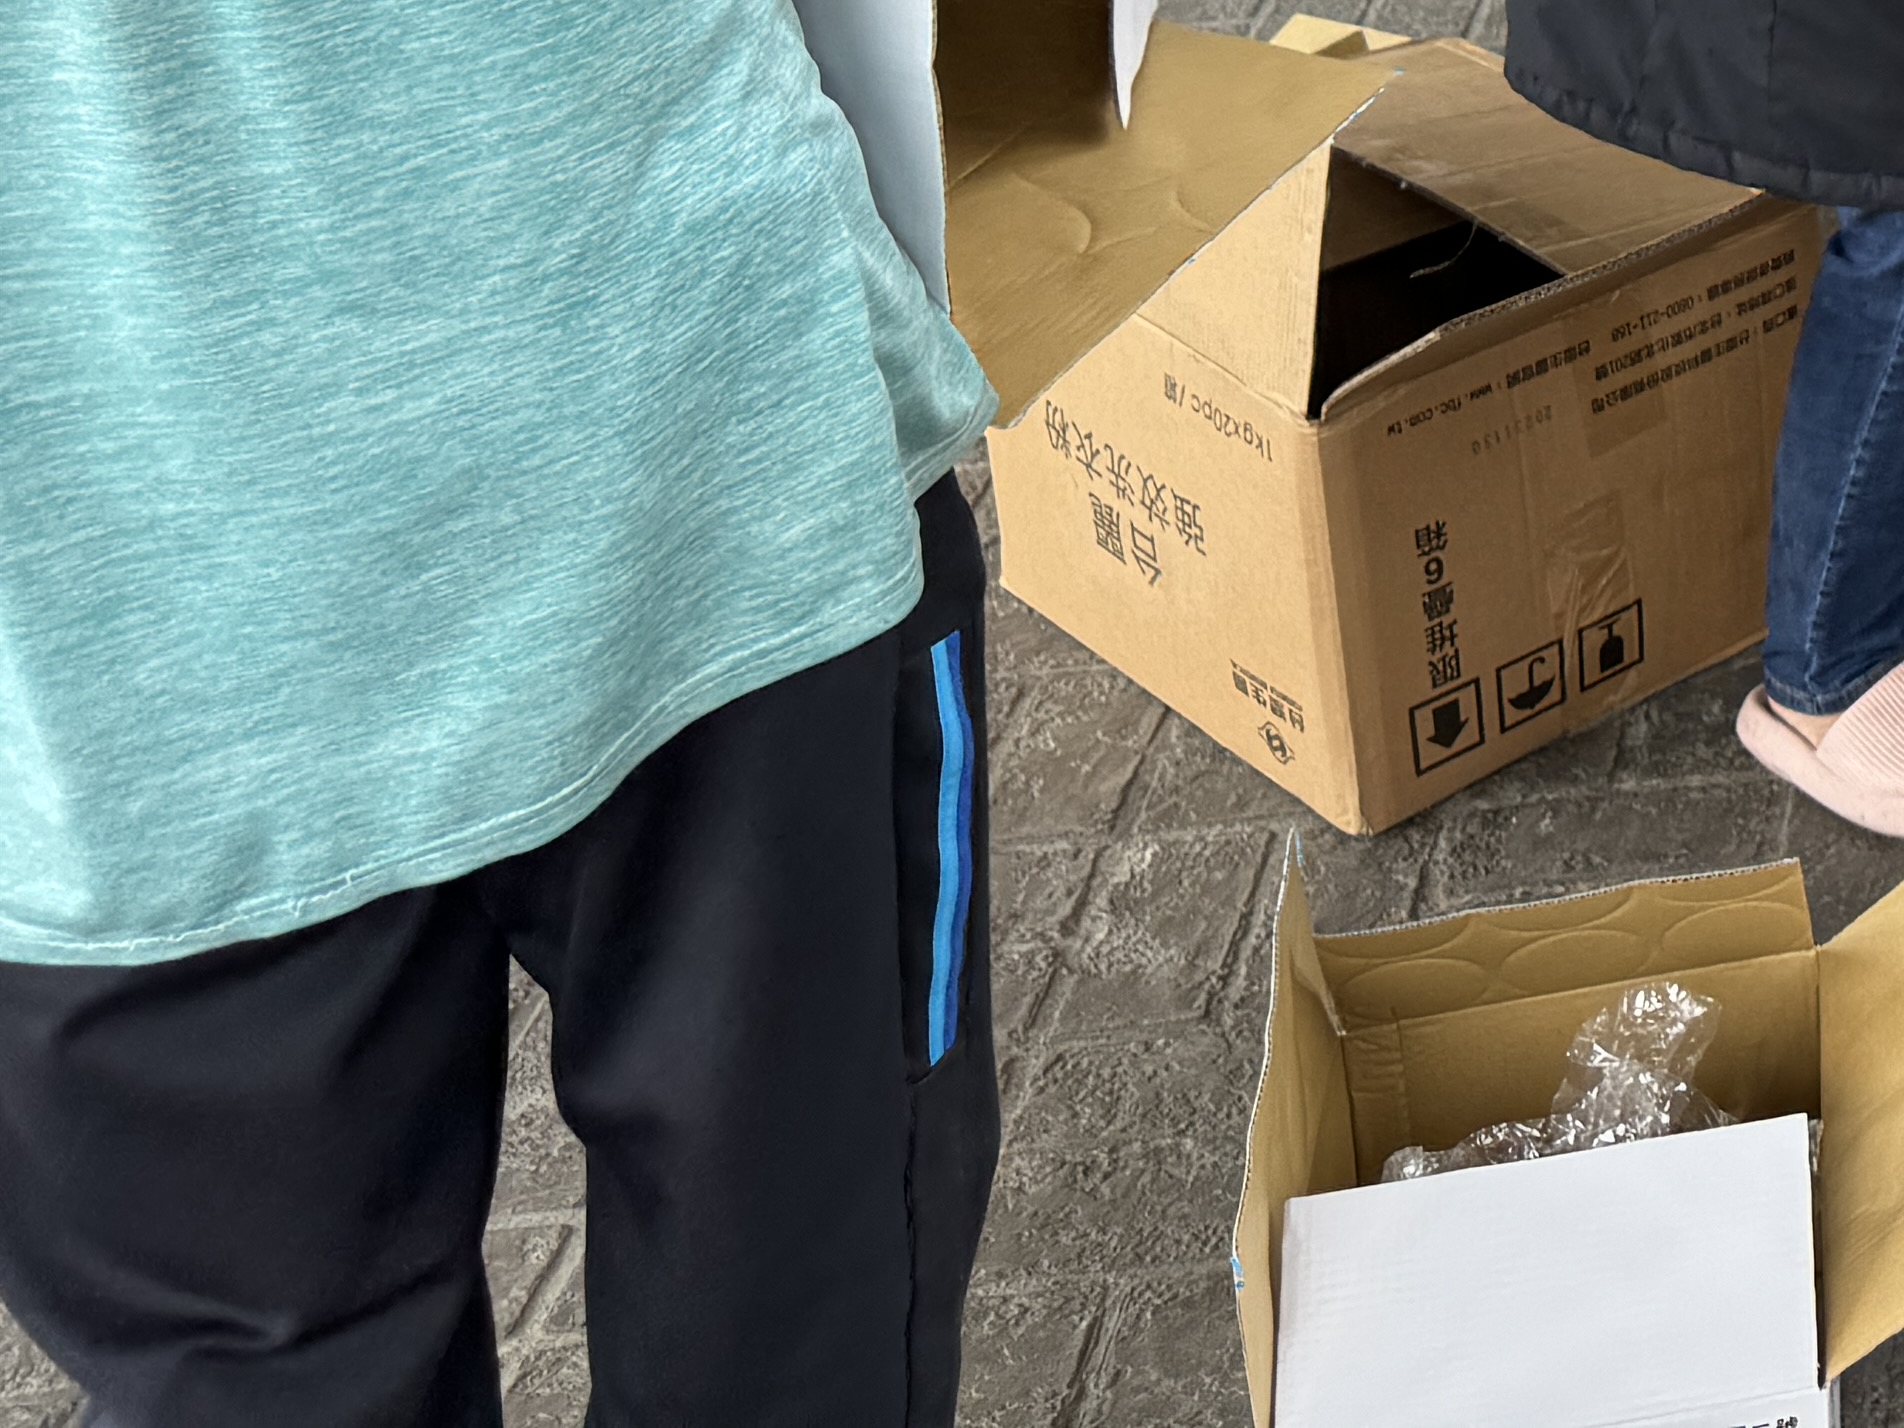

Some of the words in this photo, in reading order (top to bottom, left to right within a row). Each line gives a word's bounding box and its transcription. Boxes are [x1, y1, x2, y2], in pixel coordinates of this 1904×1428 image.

[1044, 400, 1208, 557] 強效洗衣粉
[1088, 492, 1164, 587] 台麗
[1414, 520, 1463, 688] 限堆疊6箱
